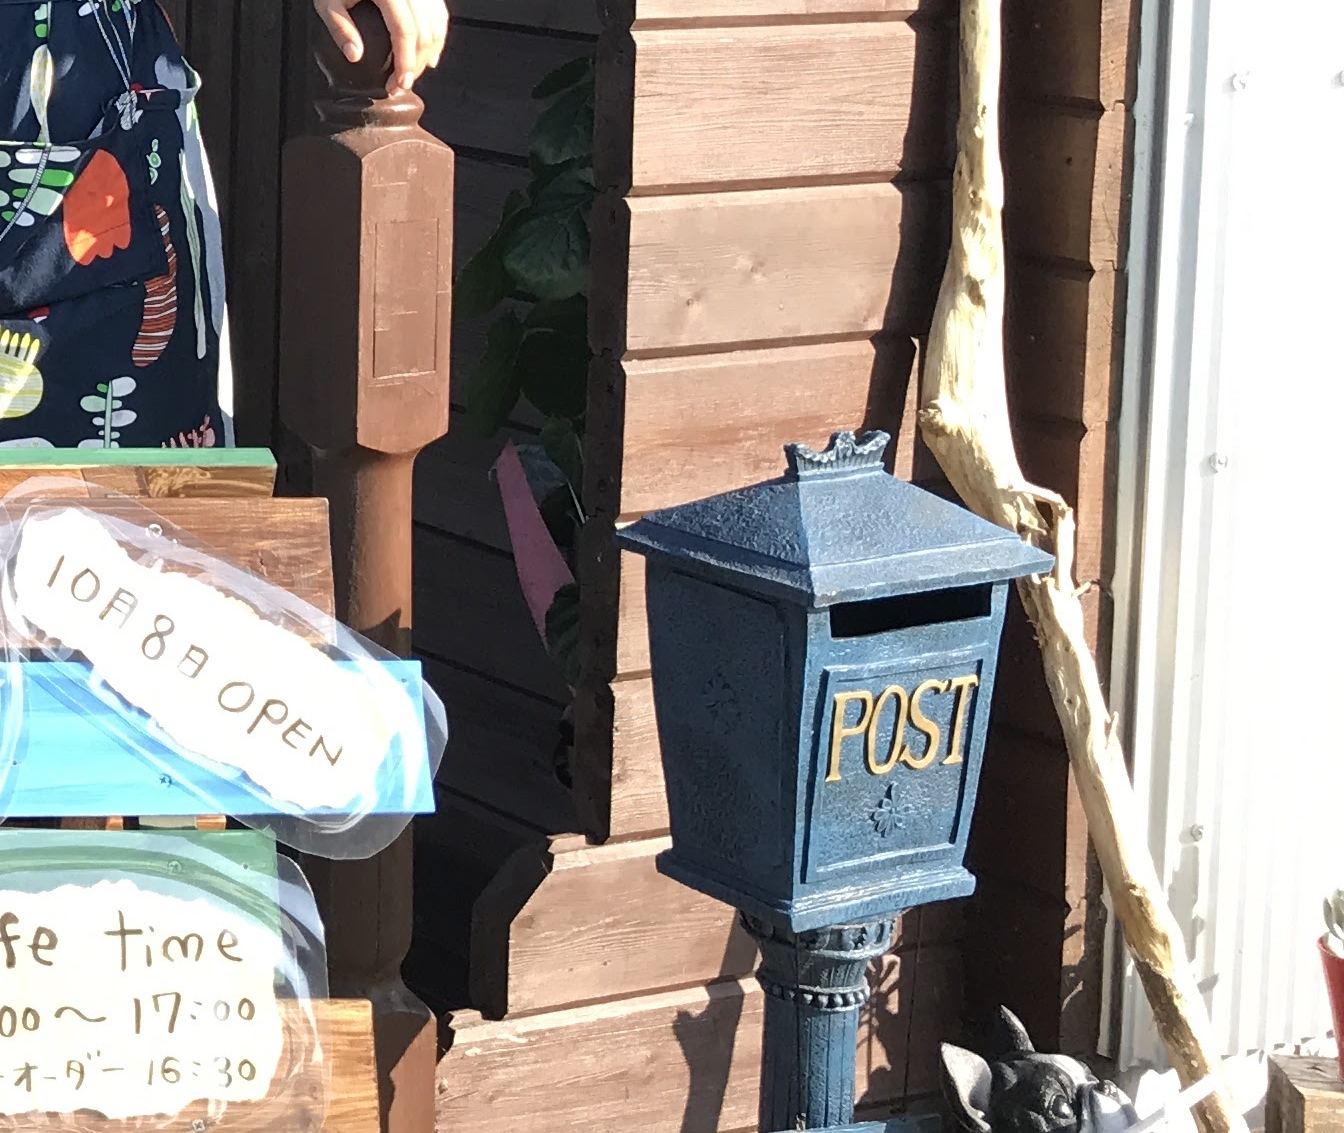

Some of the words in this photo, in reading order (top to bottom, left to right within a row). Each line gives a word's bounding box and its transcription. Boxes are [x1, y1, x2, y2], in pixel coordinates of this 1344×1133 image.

[217, 680, 344, 767] OPEN
[824, 673, 980, 783] POST
[103, 910, 244, 972] time
[147, 1055, 257, 1089] 16:30
